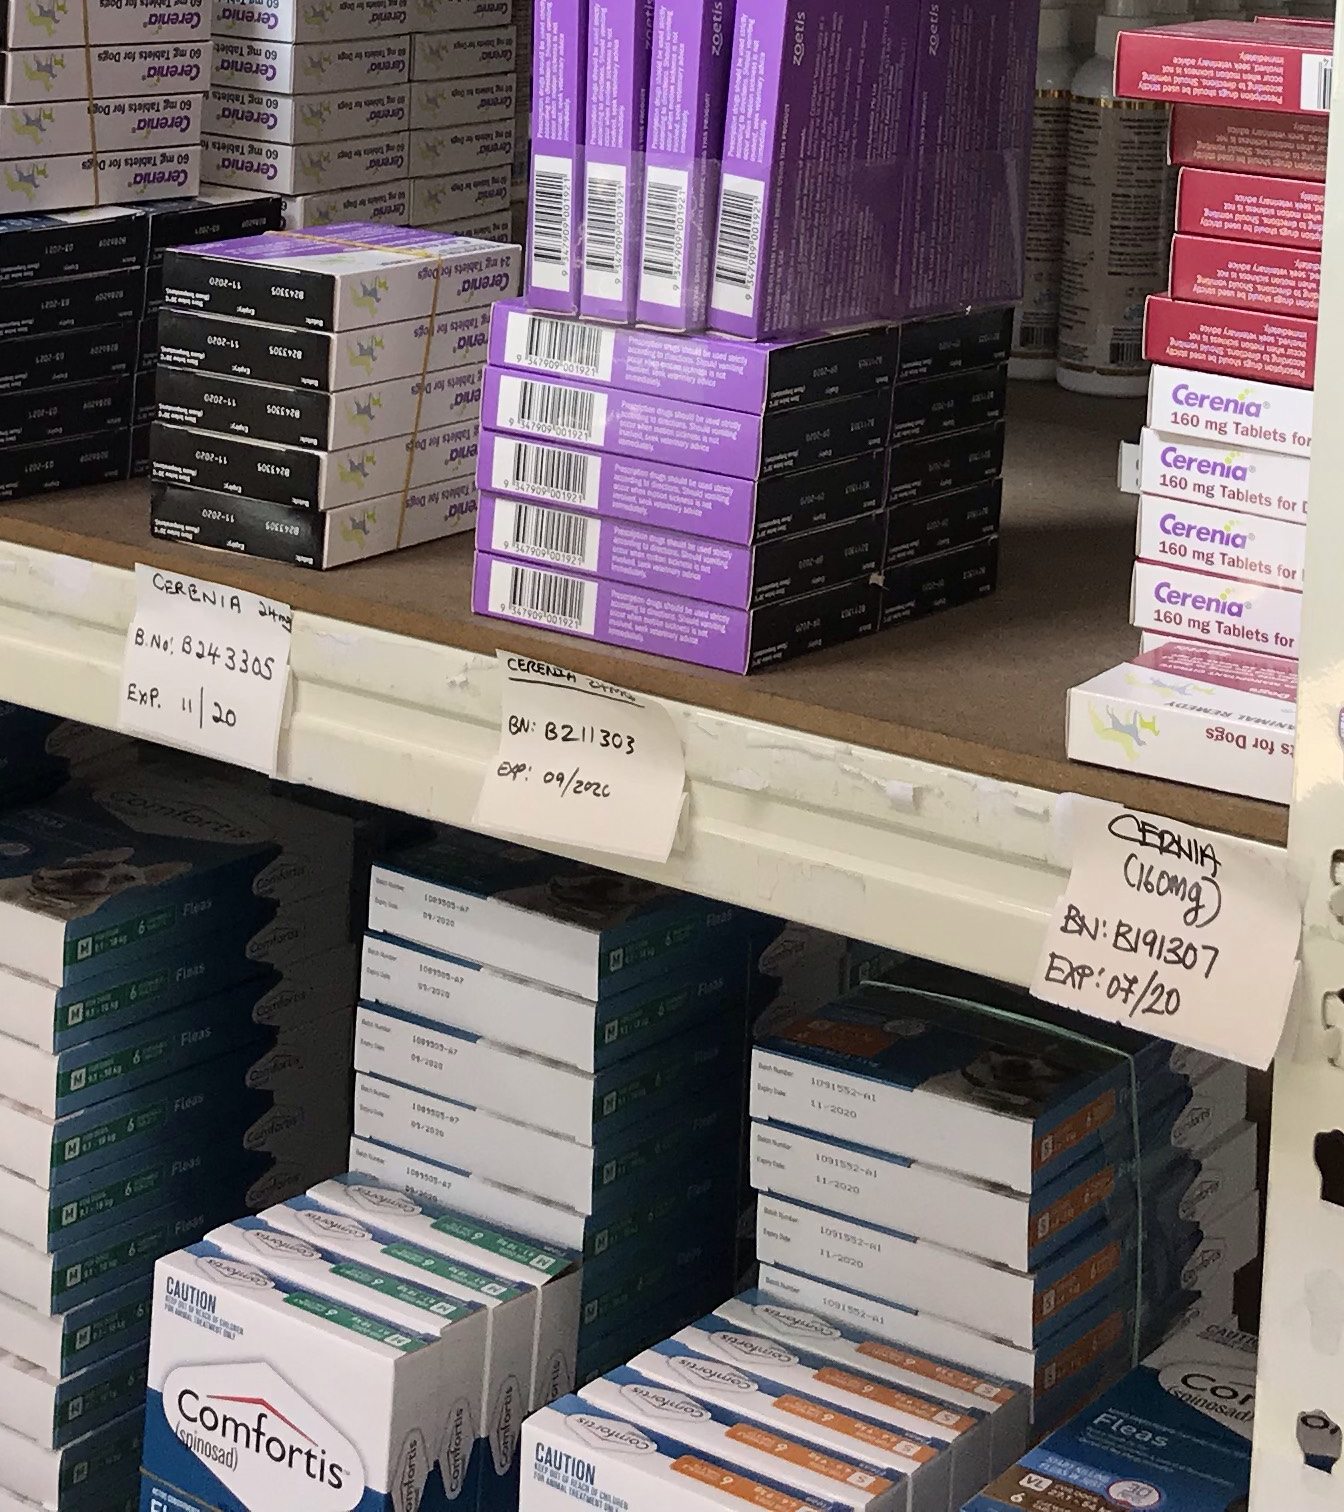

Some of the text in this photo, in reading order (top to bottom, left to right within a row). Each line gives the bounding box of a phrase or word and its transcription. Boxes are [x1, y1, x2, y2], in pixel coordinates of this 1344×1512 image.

[1170, 411, 1312, 447] 160 mg Tablets for
[1159, 473, 1297, 511] 160 mg Tablets for
[152, 573, 242, 614] CERENIA
[1153, 609, 1295, 648] 160 mg Tablets for
[507, 657, 577, 683] CERENIA
[1124, 853, 1222, 928] (160mg)
[1113, 920, 1219, 979] B191307
[1106, 970, 1181, 1018] 07/20
[166, 1276, 217, 1314] CAUTION
[175, 1420, 239, 1472] (spinosad)
[177, 1388, 344, 1490] Comfortis
[1093, 1410, 1169, 1450] Fleas
[535, 1442, 597, 1486] CAUTION
